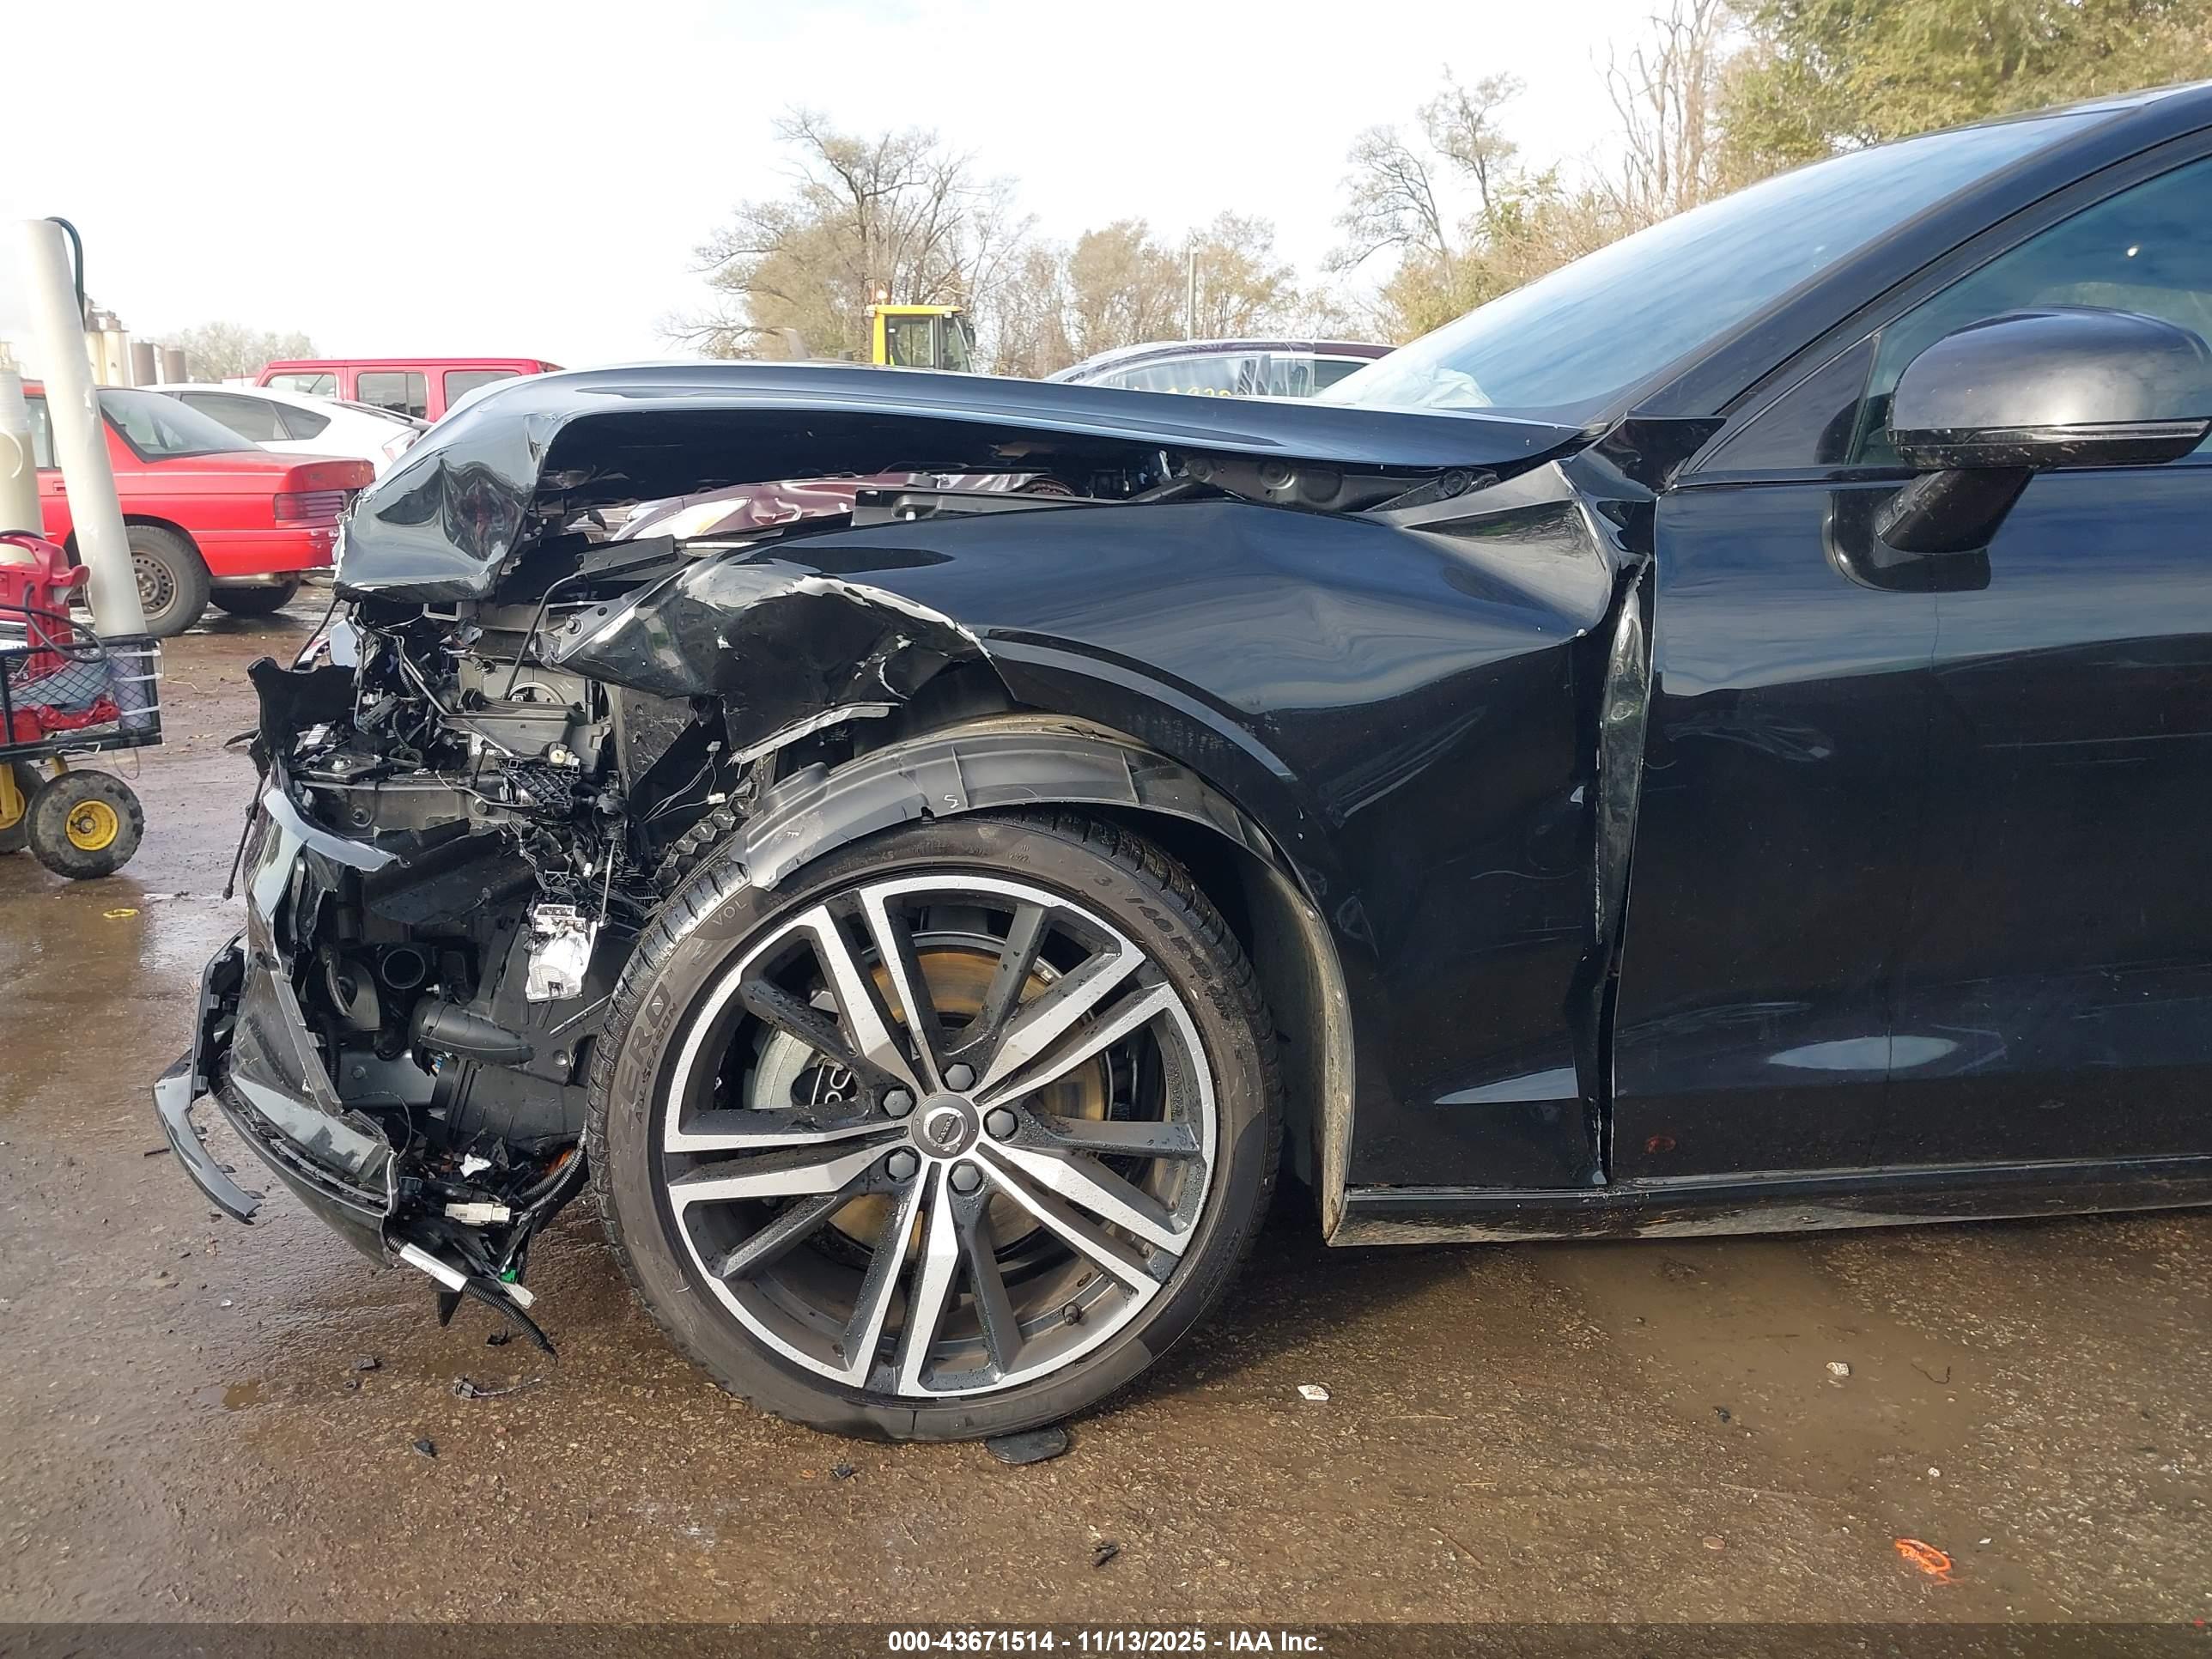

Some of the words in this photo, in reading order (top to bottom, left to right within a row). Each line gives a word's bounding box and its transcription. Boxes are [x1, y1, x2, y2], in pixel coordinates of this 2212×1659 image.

[711, 899, 749, 927] VOL
[617, 981, 672, 1142] ZERO
[642, 1002, 678, 1081] SEASON
[938, 1115, 957, 1144] VOLVO
